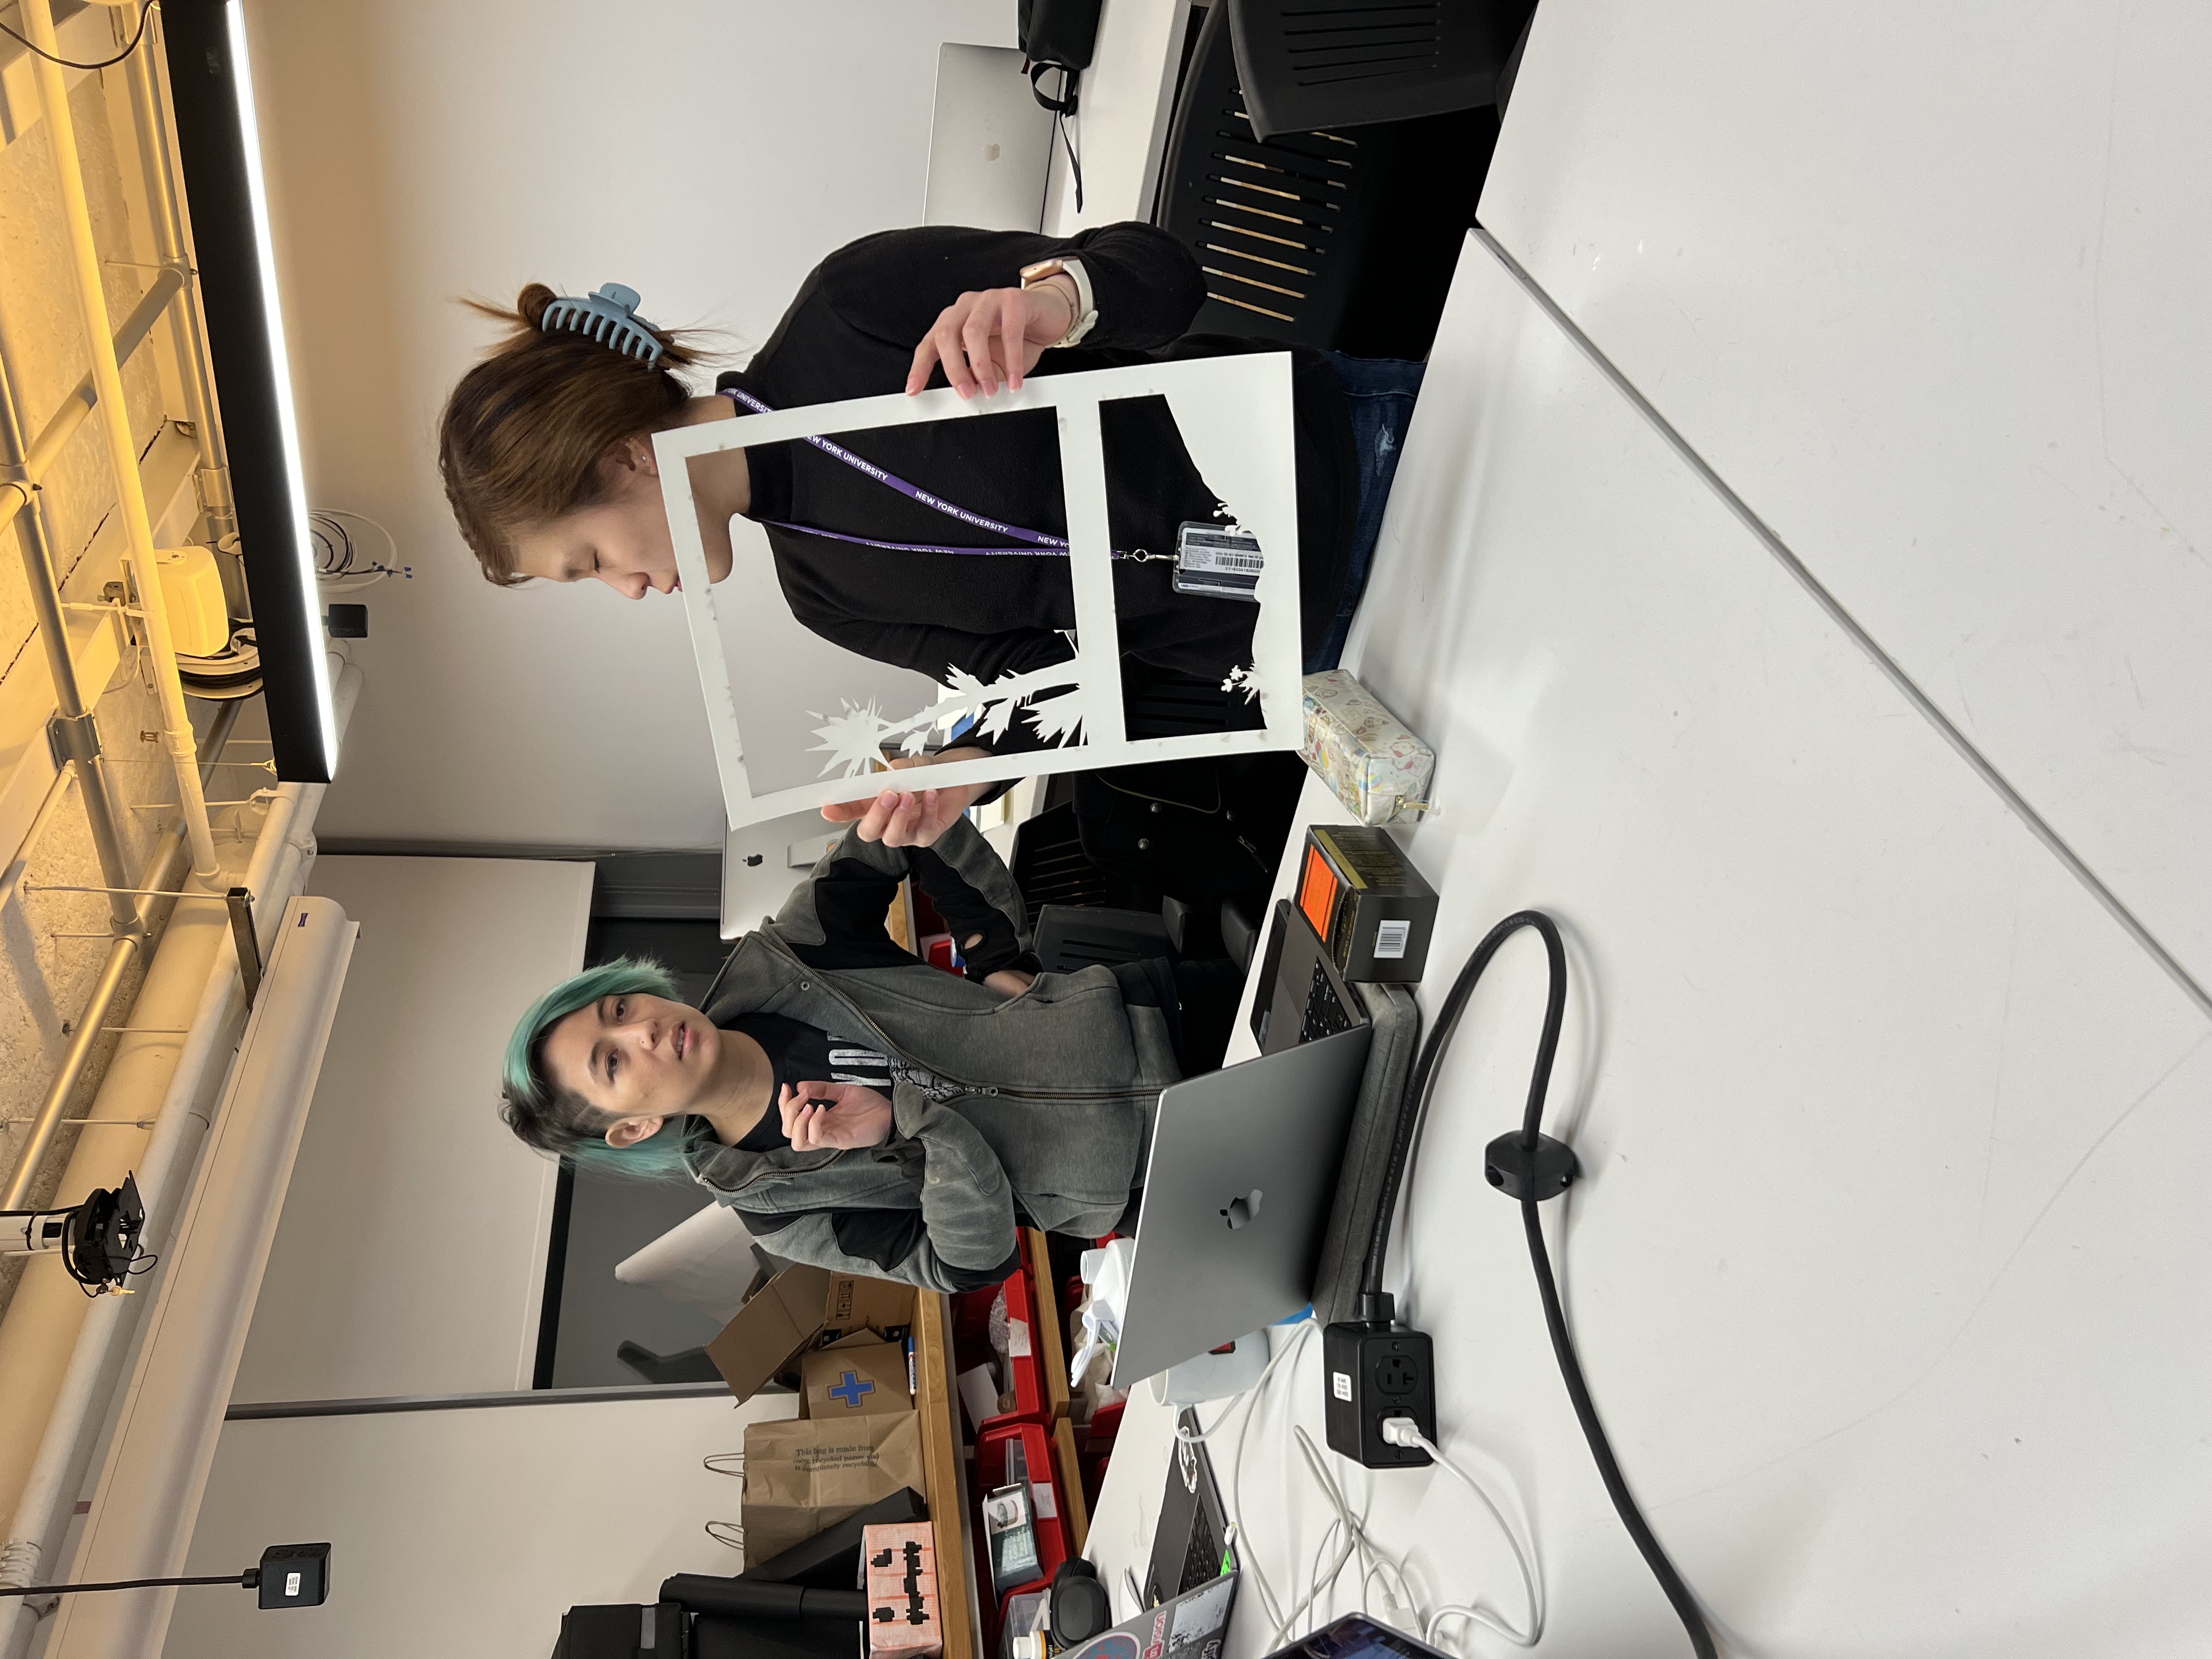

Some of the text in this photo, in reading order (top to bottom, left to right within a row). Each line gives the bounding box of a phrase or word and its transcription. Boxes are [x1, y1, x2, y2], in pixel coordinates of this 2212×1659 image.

[822, 439, 843, 458] YORK
[843, 452, 888, 481] UNIVERSITY
[915, 490, 1008, 533] NEW YORK UNIVERSITY
[1037, 535, 1070, 549] NEW YO
[796, 1448, 812, 1457] This
[858, 1444, 875, 1452] from
[812, 1455, 842, 1464] recycled
[802, 1463, 841, 1472] completely
